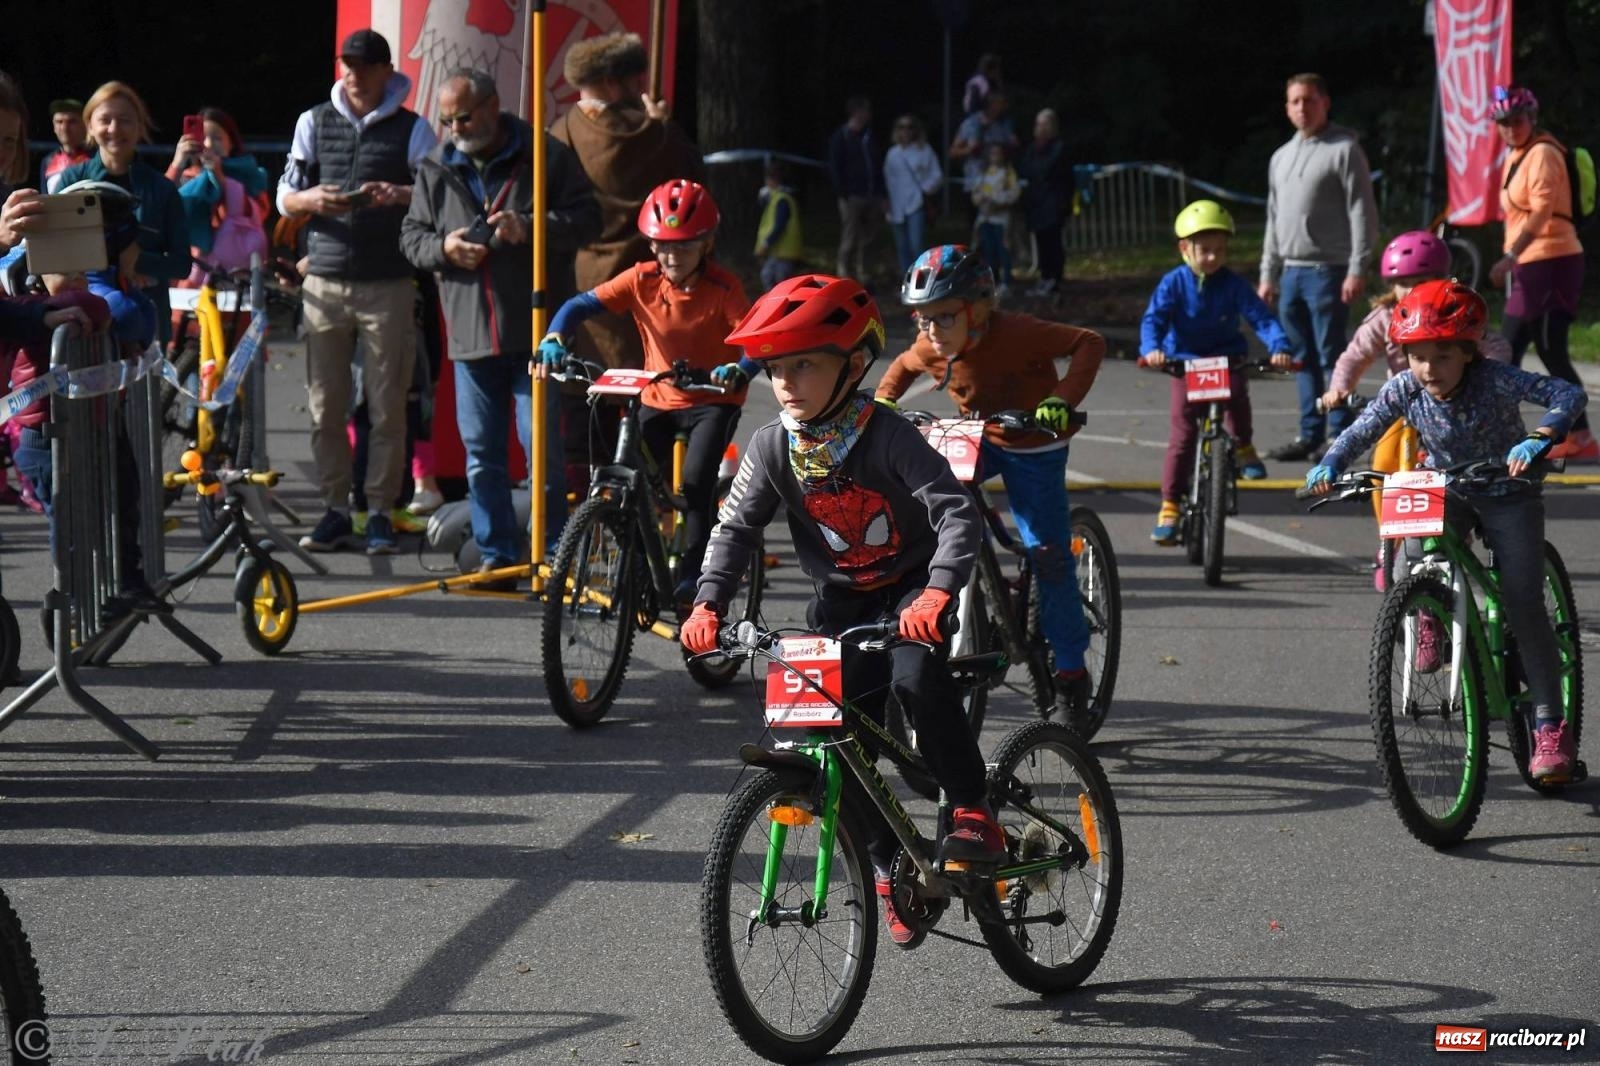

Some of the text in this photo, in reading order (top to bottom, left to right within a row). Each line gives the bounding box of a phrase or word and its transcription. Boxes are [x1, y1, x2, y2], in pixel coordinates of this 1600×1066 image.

[1197, 371, 1219, 385] 74
[1395, 493, 1429, 513] 83
[783, 668, 823, 693] 93
